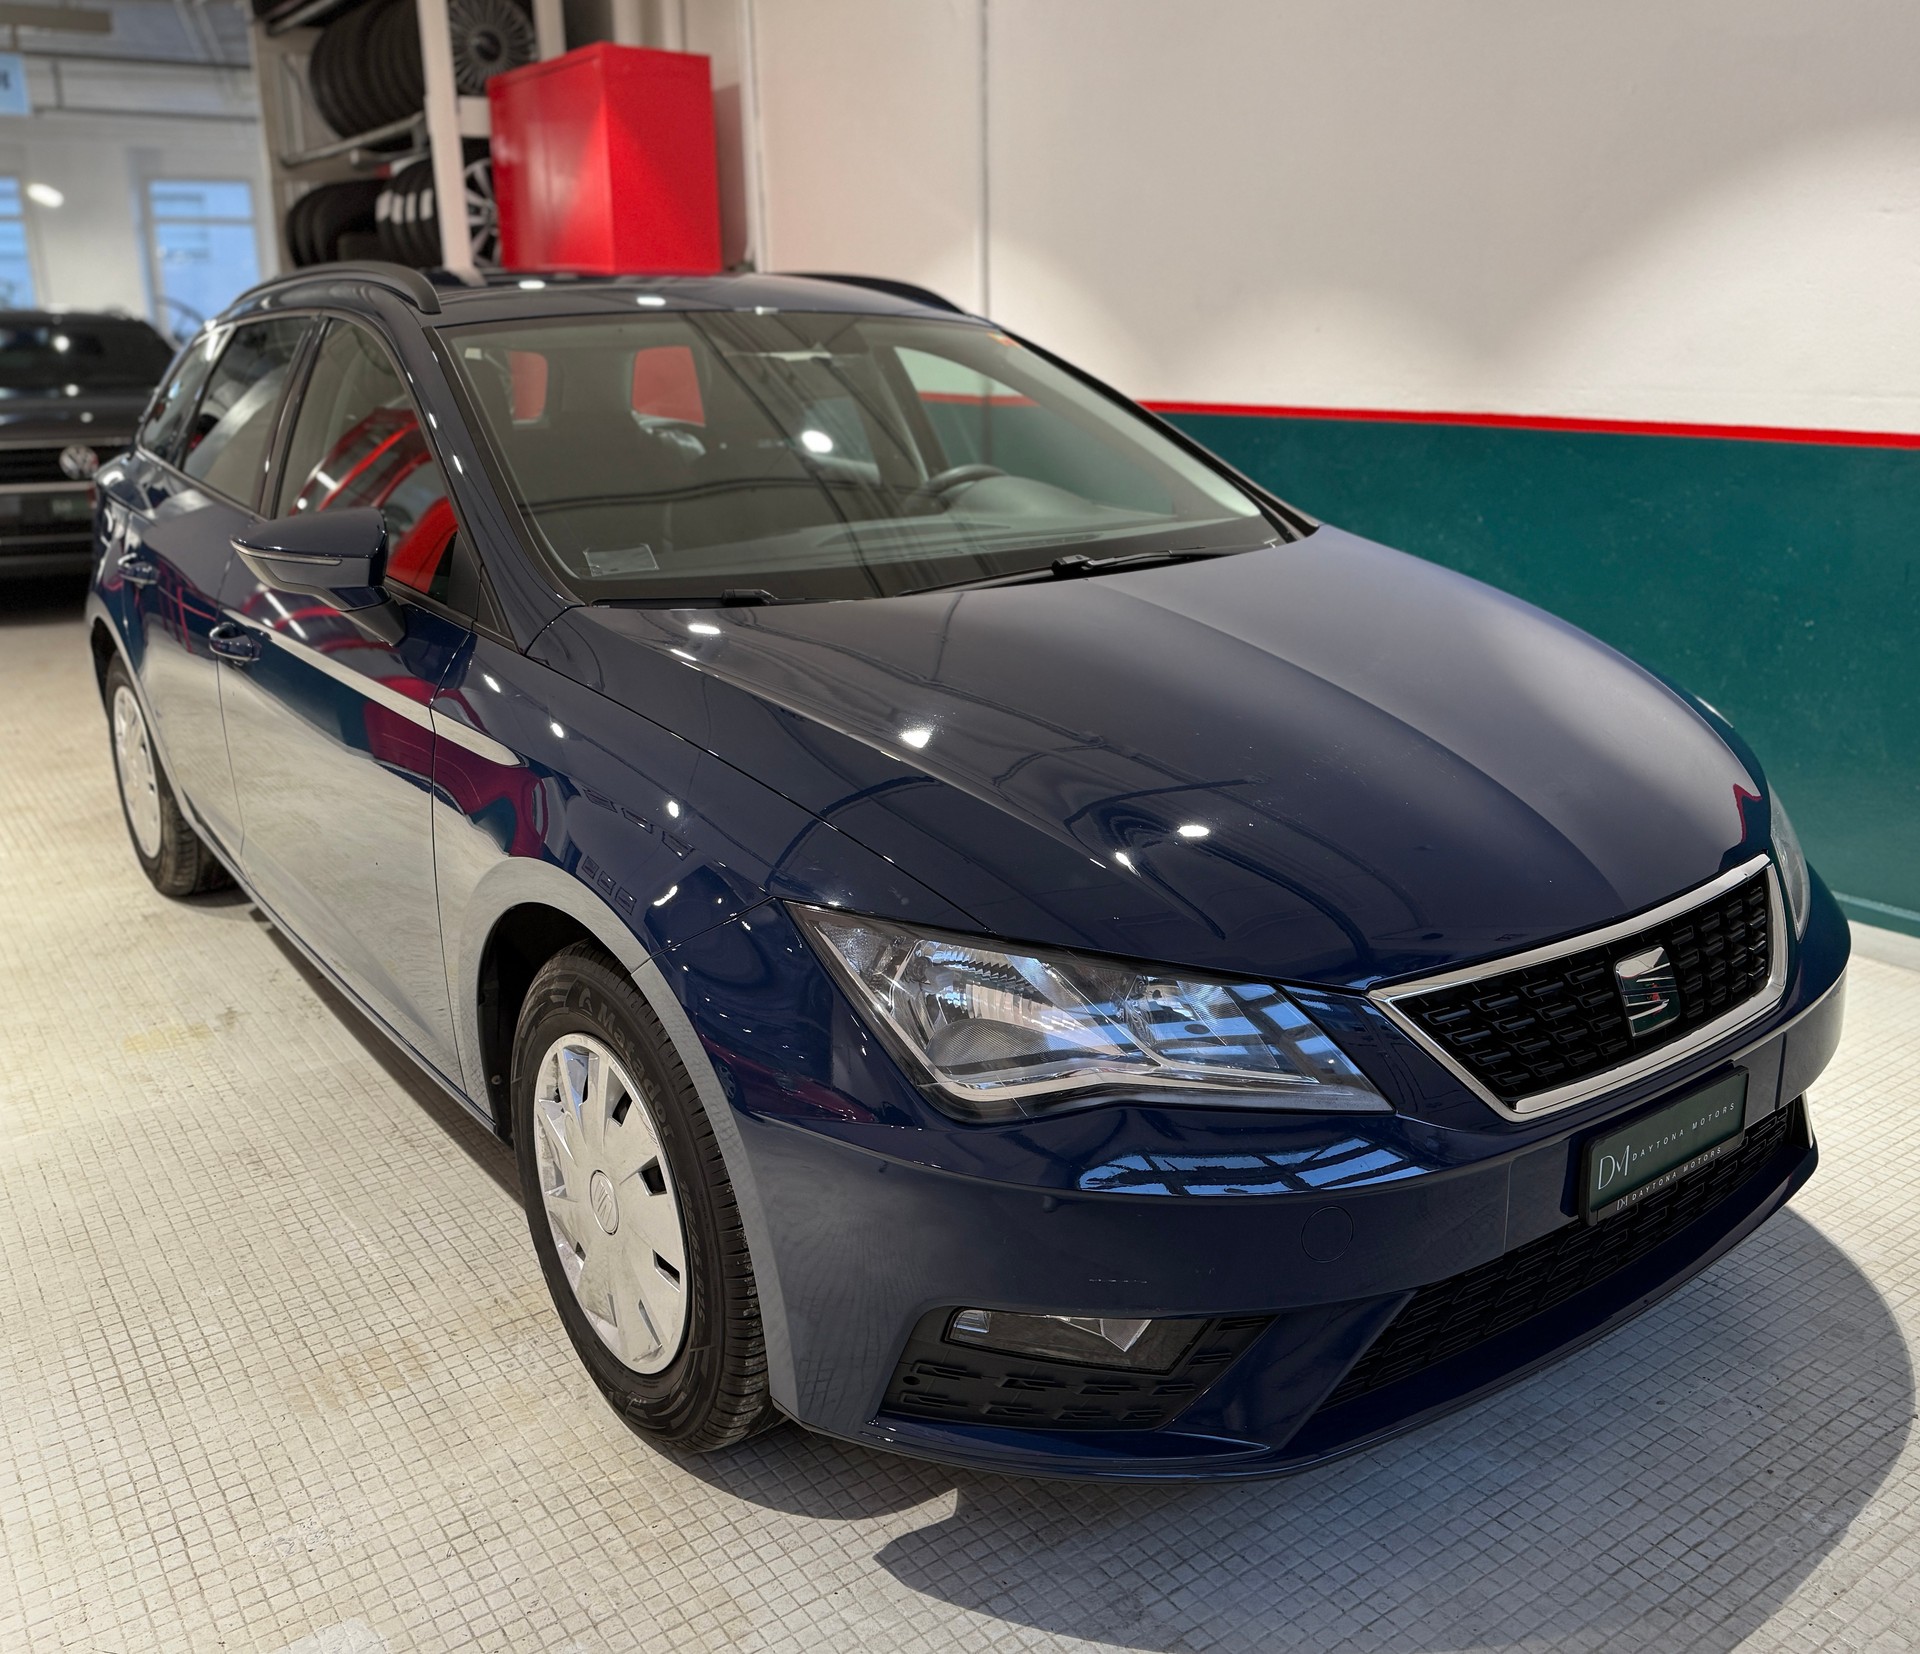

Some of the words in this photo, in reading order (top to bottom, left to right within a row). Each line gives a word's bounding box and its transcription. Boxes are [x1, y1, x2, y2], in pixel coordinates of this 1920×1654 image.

[597, 1001, 675, 1139] Matador
[1632, 1129, 1684, 1161] DAYTONA
[1692, 1102, 1735, 1130] MOTORS
[1632, 1172, 1677, 1201] DAYTONA
[1684, 1146, 1722, 1172] MOTORS
